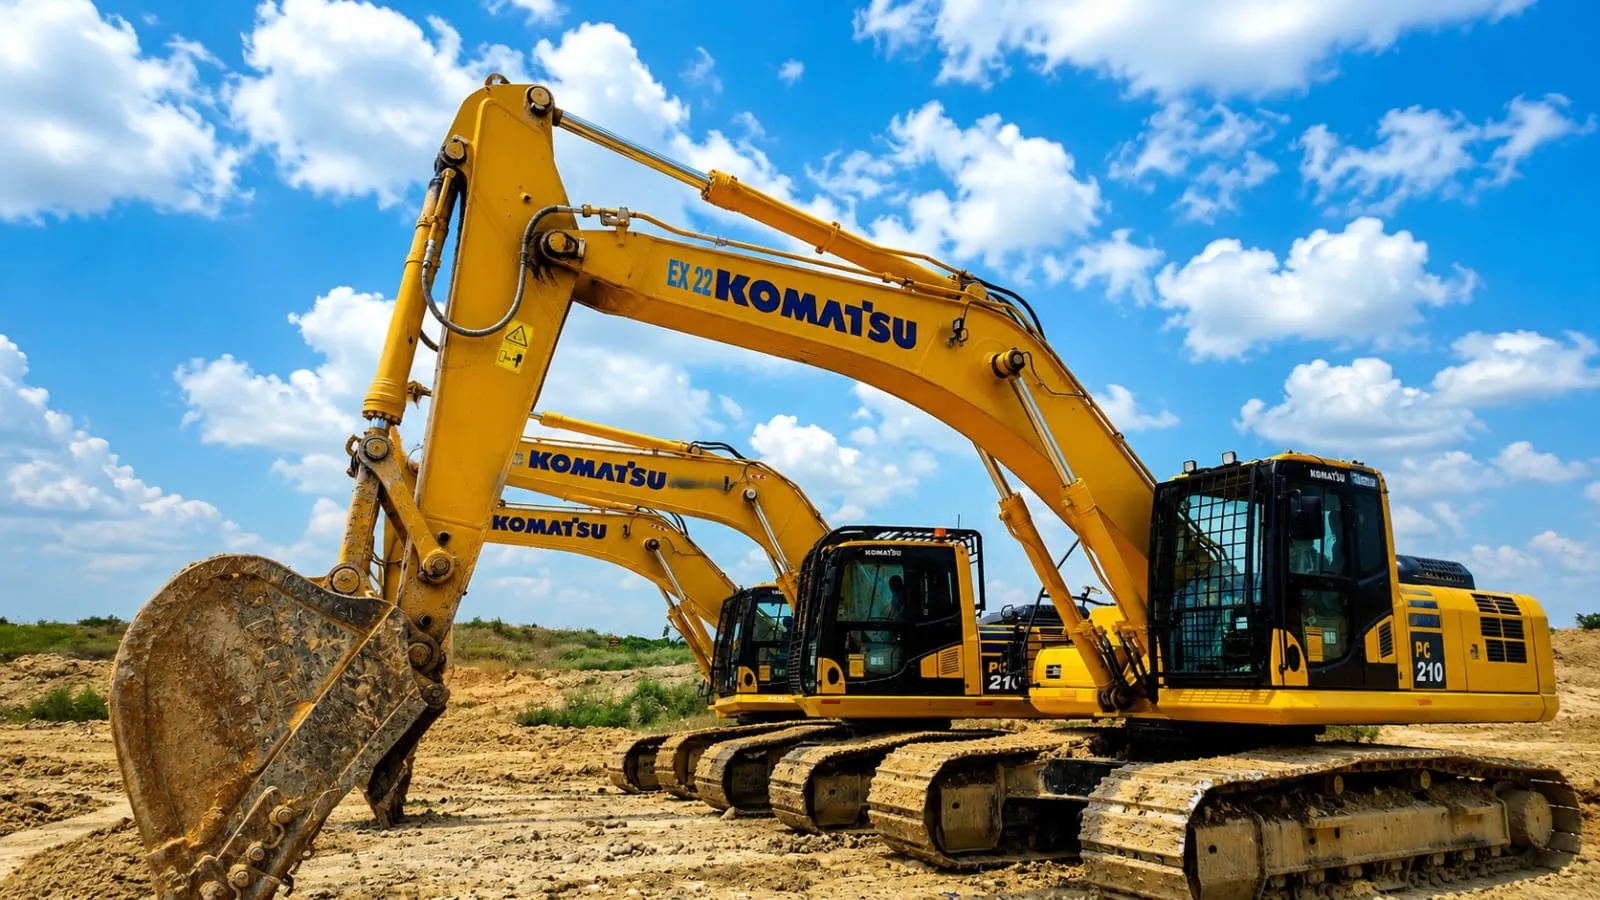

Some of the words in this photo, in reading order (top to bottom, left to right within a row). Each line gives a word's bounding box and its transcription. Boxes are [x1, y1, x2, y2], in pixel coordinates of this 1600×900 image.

[666, 258, 691, 291] EX
[692, 265, 714, 297] 22
[715, 268, 917, 350] KOMATSU
[528, 449, 667, 490] KOMATSU
[1310, 468, 1345, 483] KOMATSU
[492, 515, 607, 539] KOMATSU
[864, 548, 902, 557] KOMATSU
[1415, 641, 1431, 660] PC
[1416, 661, 1444, 683] 210
